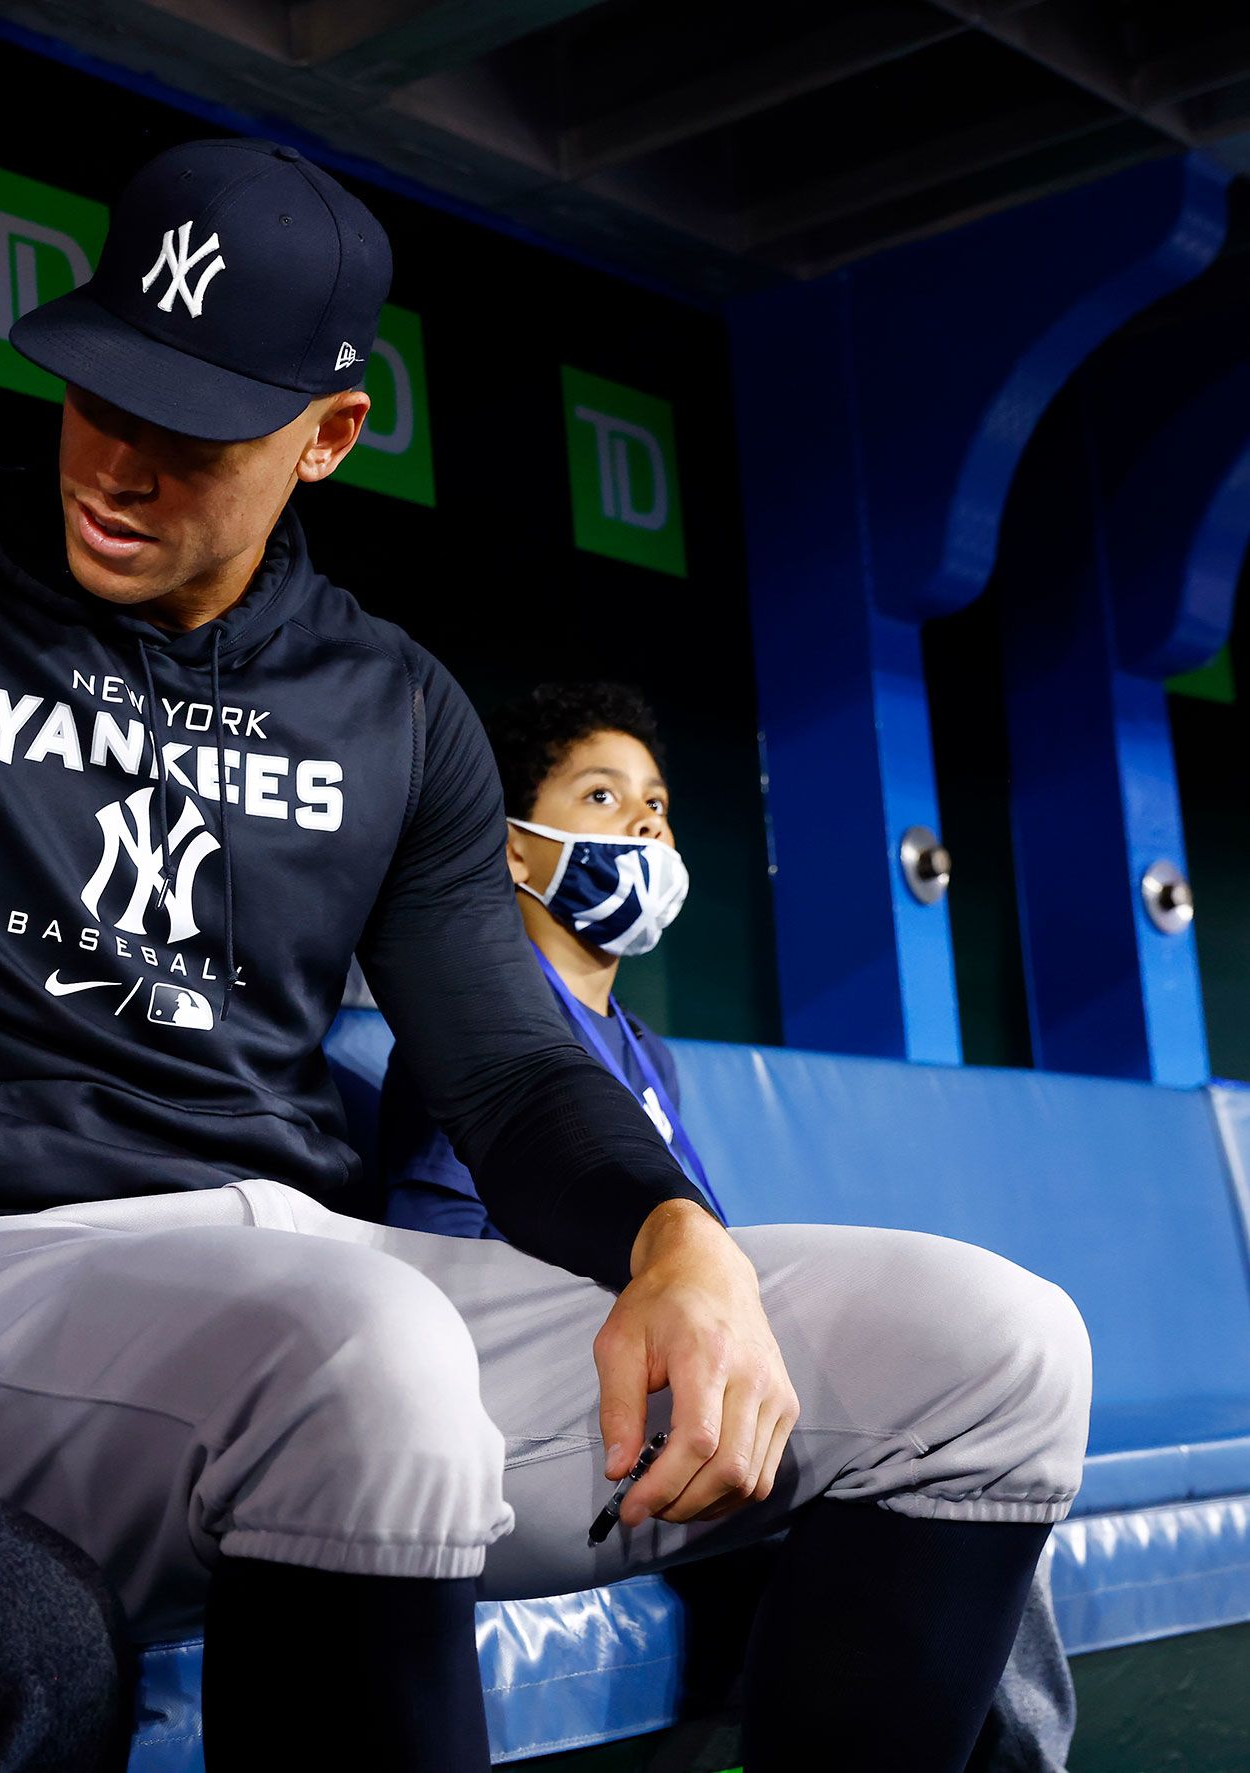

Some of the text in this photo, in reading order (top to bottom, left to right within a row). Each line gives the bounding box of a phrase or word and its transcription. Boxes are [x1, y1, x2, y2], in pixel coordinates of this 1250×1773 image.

[142, 220, 226, 319] NY
[573, 403, 668, 532] TD
[72, 669, 272, 740] NEW YORK
[80, 786, 222, 944] NY
